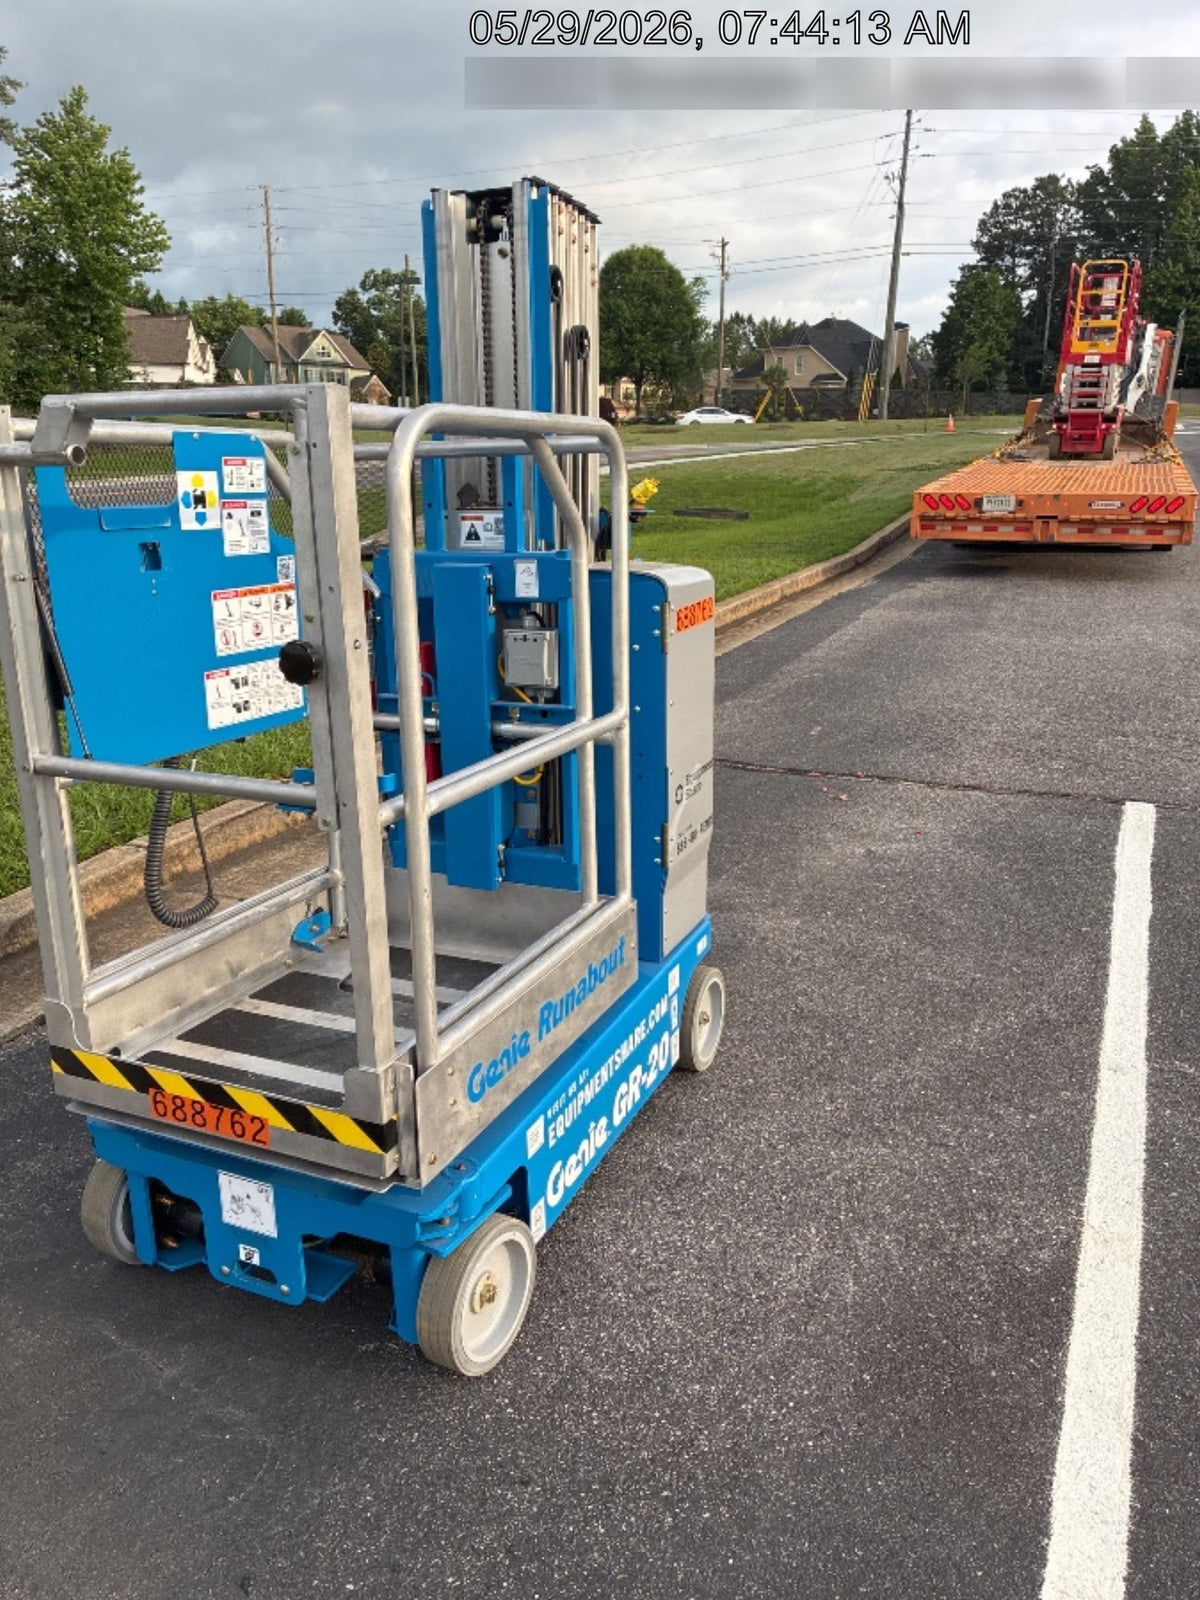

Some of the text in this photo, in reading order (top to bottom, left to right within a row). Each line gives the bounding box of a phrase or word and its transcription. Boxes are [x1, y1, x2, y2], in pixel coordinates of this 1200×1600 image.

[466, 937, 626, 1104] Genie Runabout
[153, 1090, 268, 1145] 688762
[546, 1031, 670, 1207] Genie GR-20
